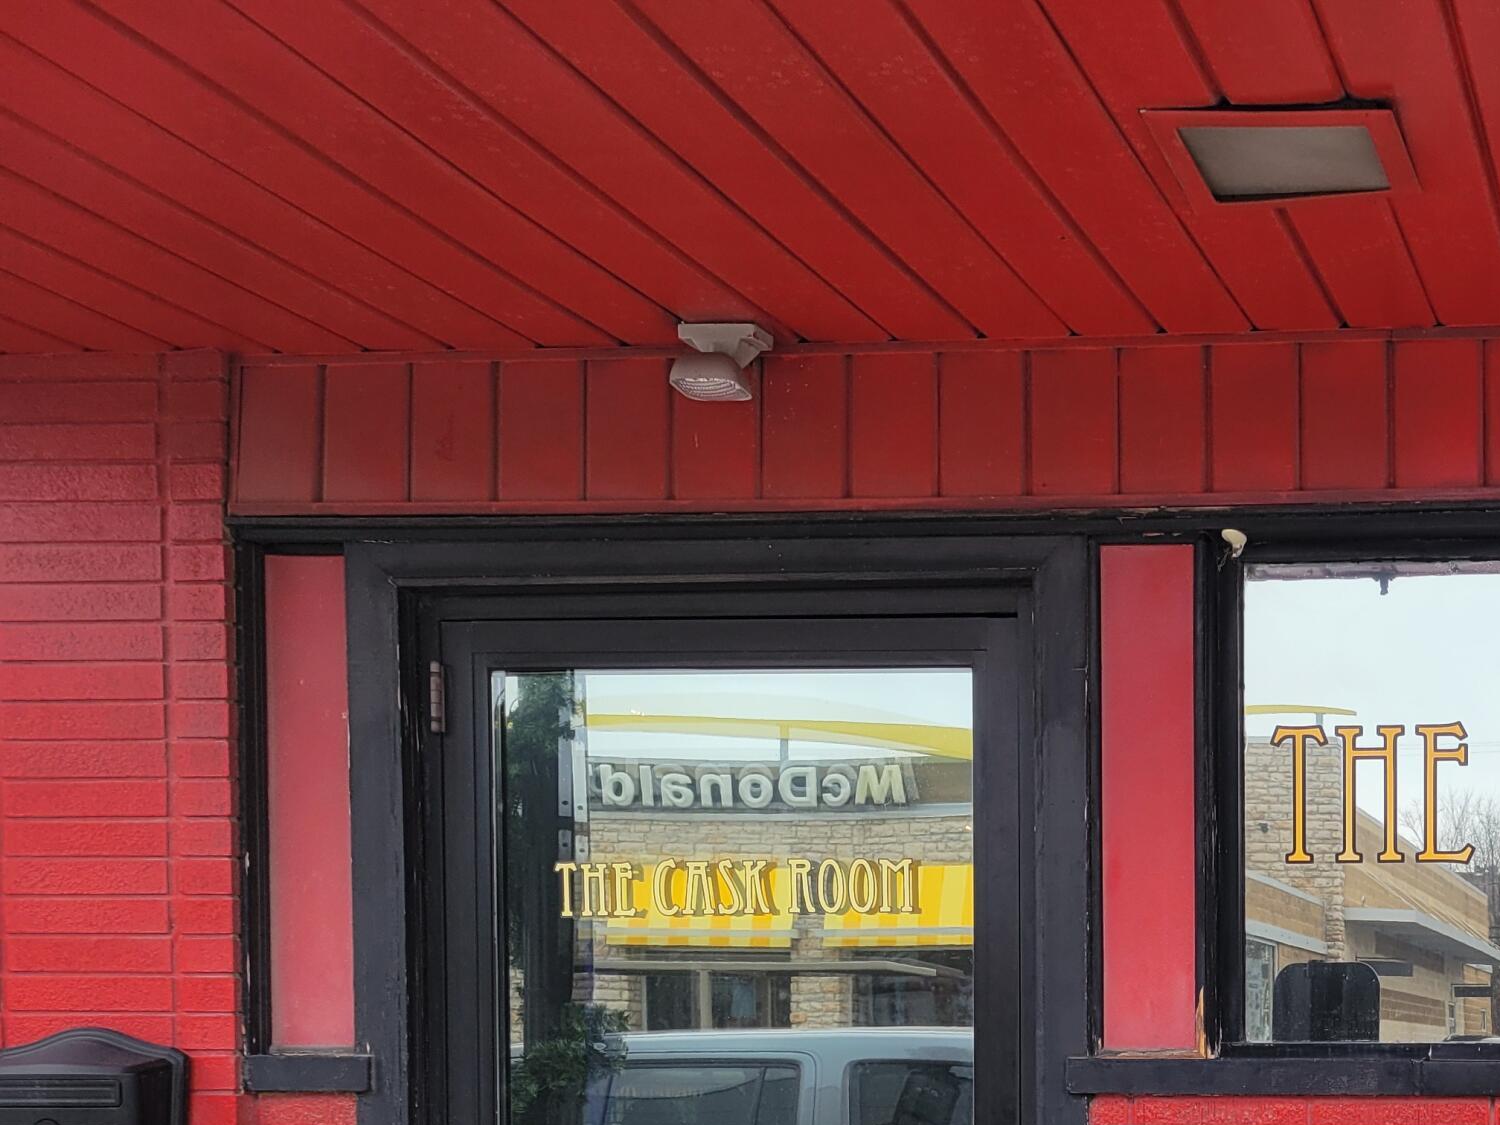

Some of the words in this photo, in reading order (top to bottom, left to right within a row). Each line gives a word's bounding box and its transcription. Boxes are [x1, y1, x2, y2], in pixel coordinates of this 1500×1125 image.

[1270, 720, 1476, 865] THE
[554, 860, 638, 918] THE
[652, 858, 770, 917] CASK
[786, 858, 914, 915] ROOM
